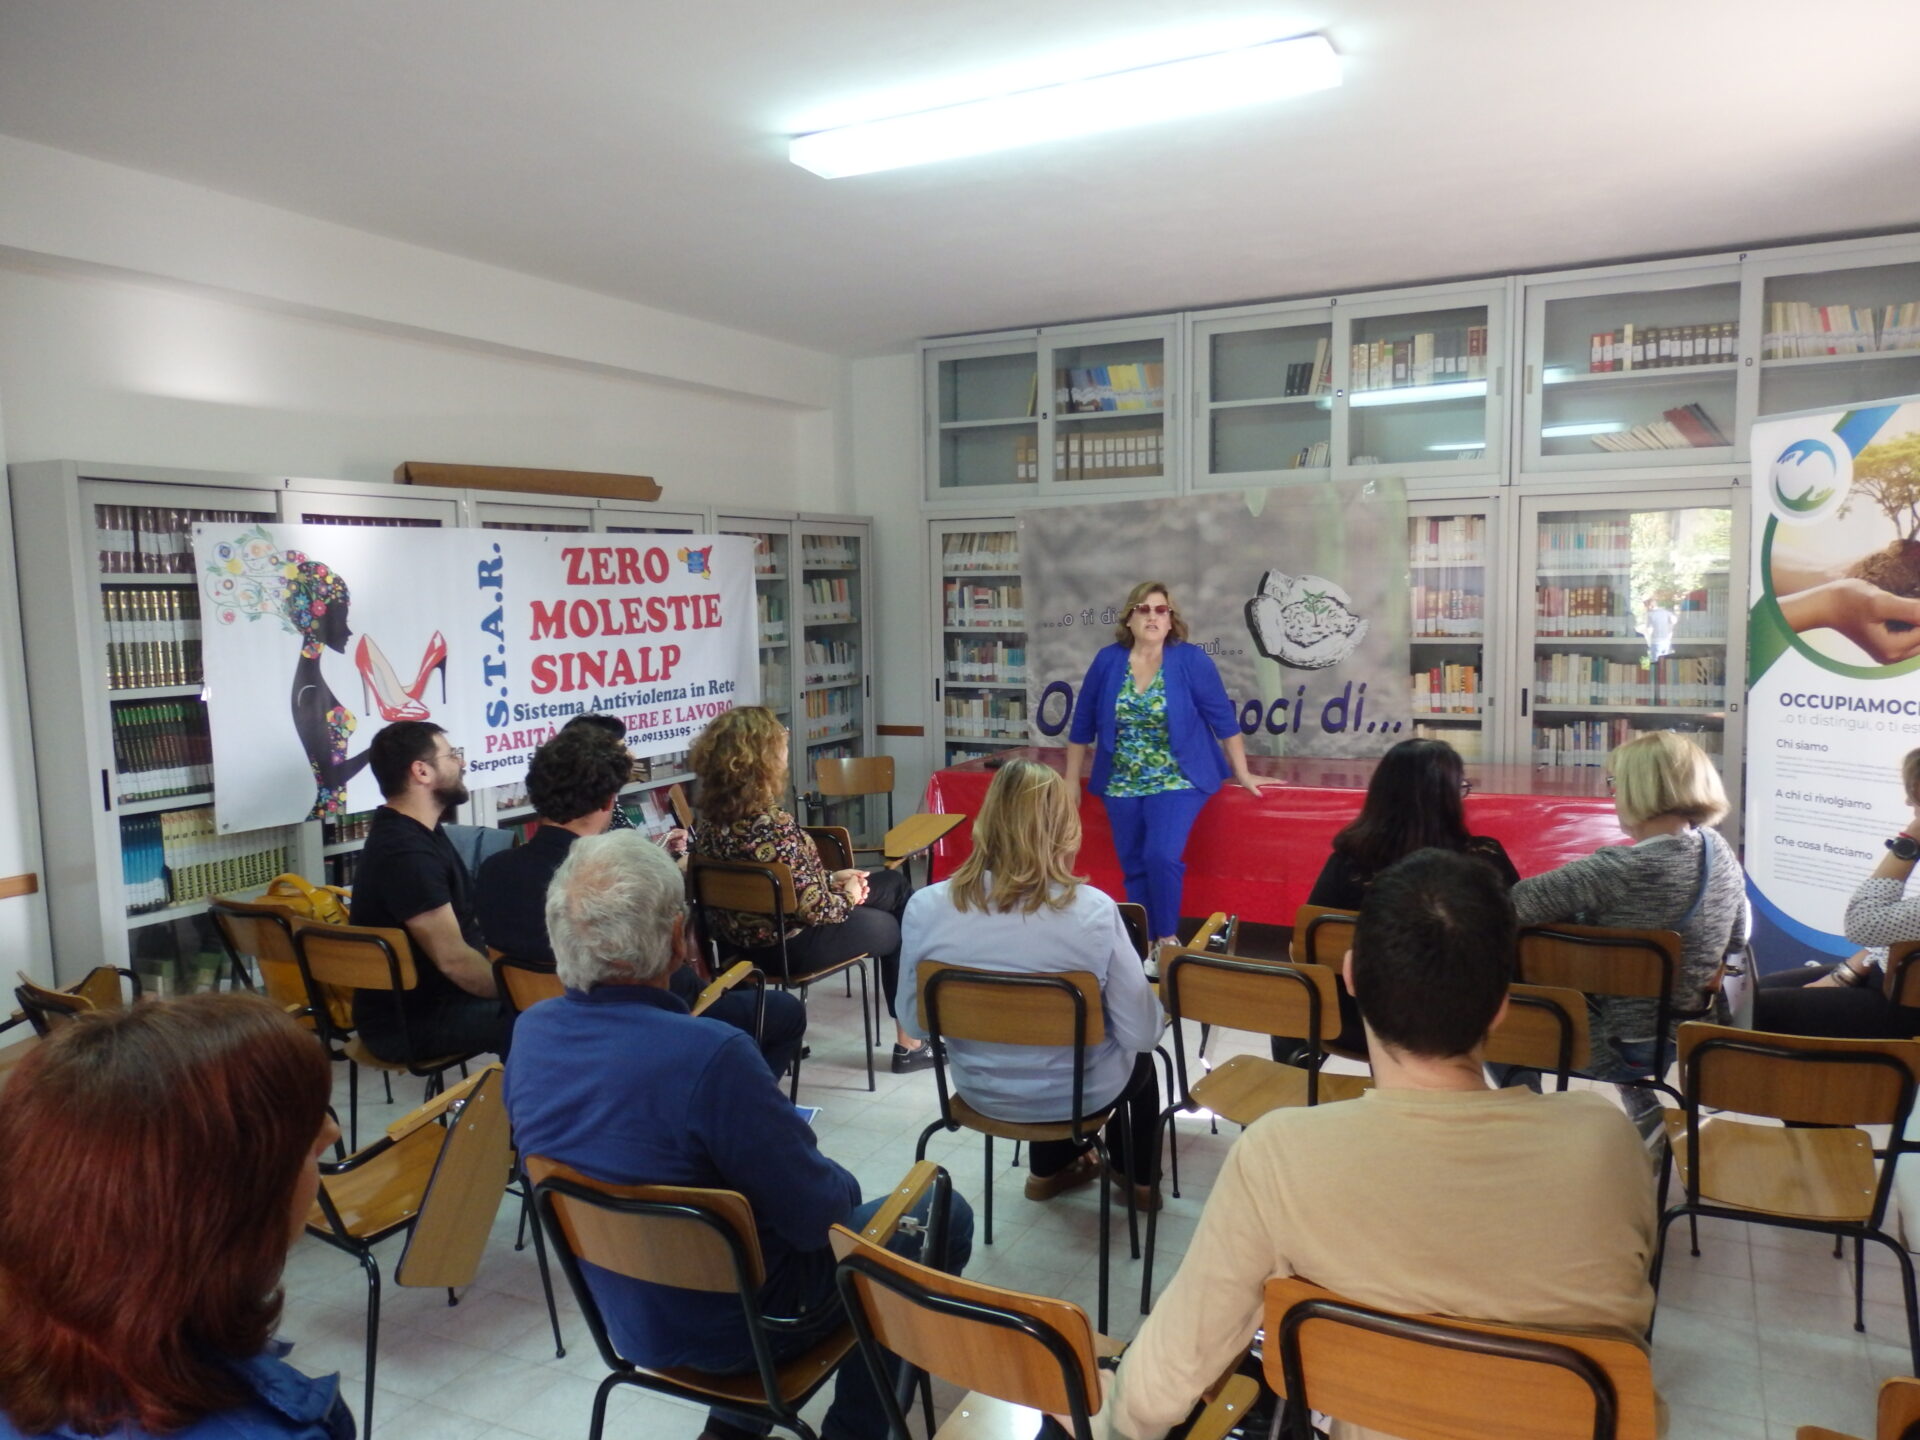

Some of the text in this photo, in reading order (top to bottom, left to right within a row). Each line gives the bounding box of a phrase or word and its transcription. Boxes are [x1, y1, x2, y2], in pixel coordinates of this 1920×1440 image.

[1731, 477, 1740, 486] A
[561, 547, 670, 585] ZERO
[529, 593, 722, 640] MOLESTIE
[1081, 608, 1095, 625] ti
[1101, 606, 1122, 625] di
[478, 542, 509, 728] S.T.A.R.
[530, 644, 681, 694] SINALP
[513, 680, 735, 722] Sistema Antiviolenza in Rete
[1321, 680, 1402, 734] di...
[485, 721, 557, 753] PARITÀ
[662, 709, 672, 725] E
[1875, 721, 1885, 732] o
[1776, 738, 1829, 752] Chi siamo
[470, 754, 524, 772] Serpotta
[1775, 788, 1872, 810] A chi ci rivolgiamo
[1774, 835, 1873, 860] Che cosa facciamo
